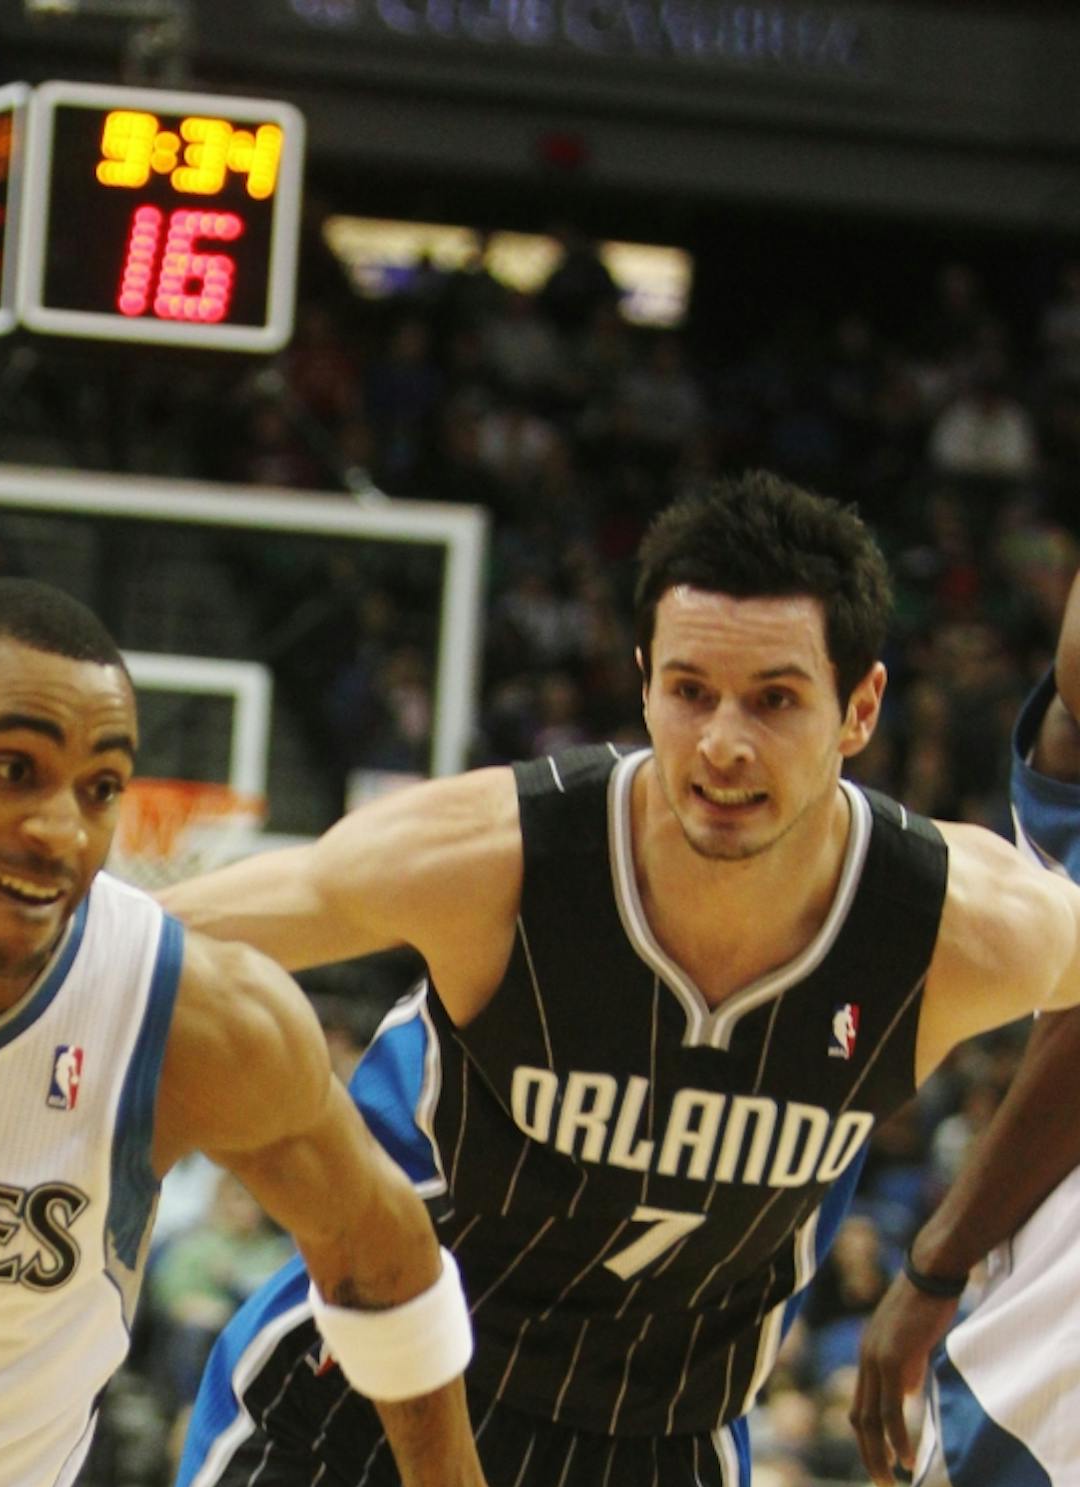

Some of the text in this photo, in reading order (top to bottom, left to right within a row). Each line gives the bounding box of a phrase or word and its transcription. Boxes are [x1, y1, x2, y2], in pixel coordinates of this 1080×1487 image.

[96, 110, 284, 199] 9:34
[118, 204, 244, 322] 16
[510, 1064, 874, 1188] ORLANDO
[603, 1205, 707, 1281] 7
